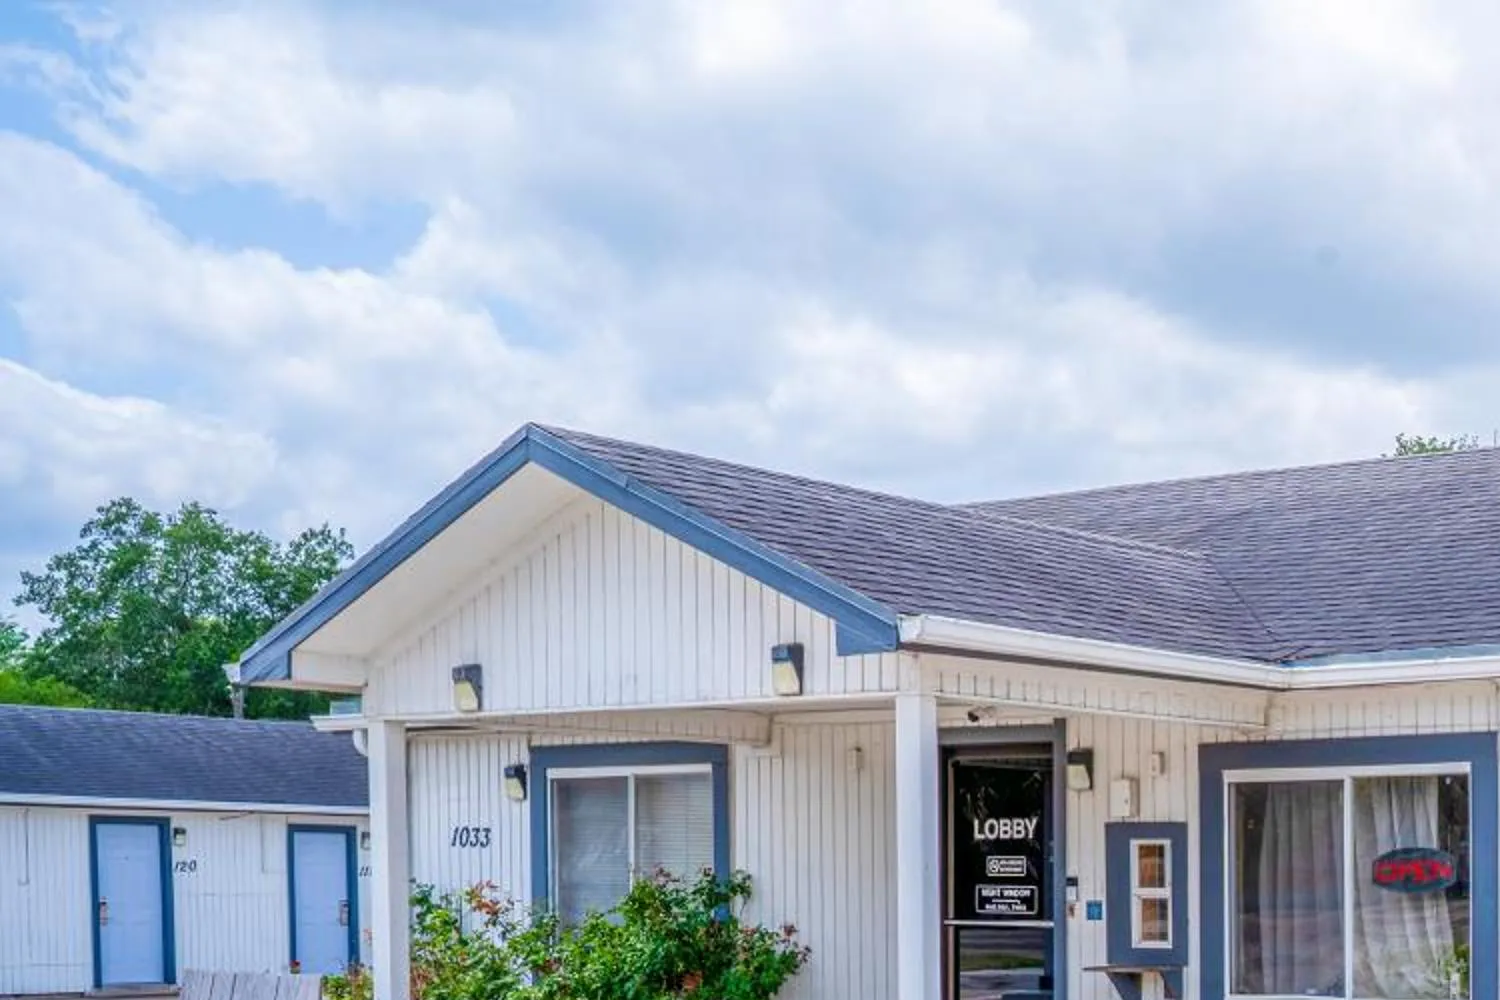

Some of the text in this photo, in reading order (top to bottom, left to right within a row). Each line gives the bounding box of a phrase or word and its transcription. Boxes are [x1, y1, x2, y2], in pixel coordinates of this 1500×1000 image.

[451, 826, 492, 848] 1033
[974, 817, 1038, 840] LOBBY
[175, 860, 197, 872] 120
